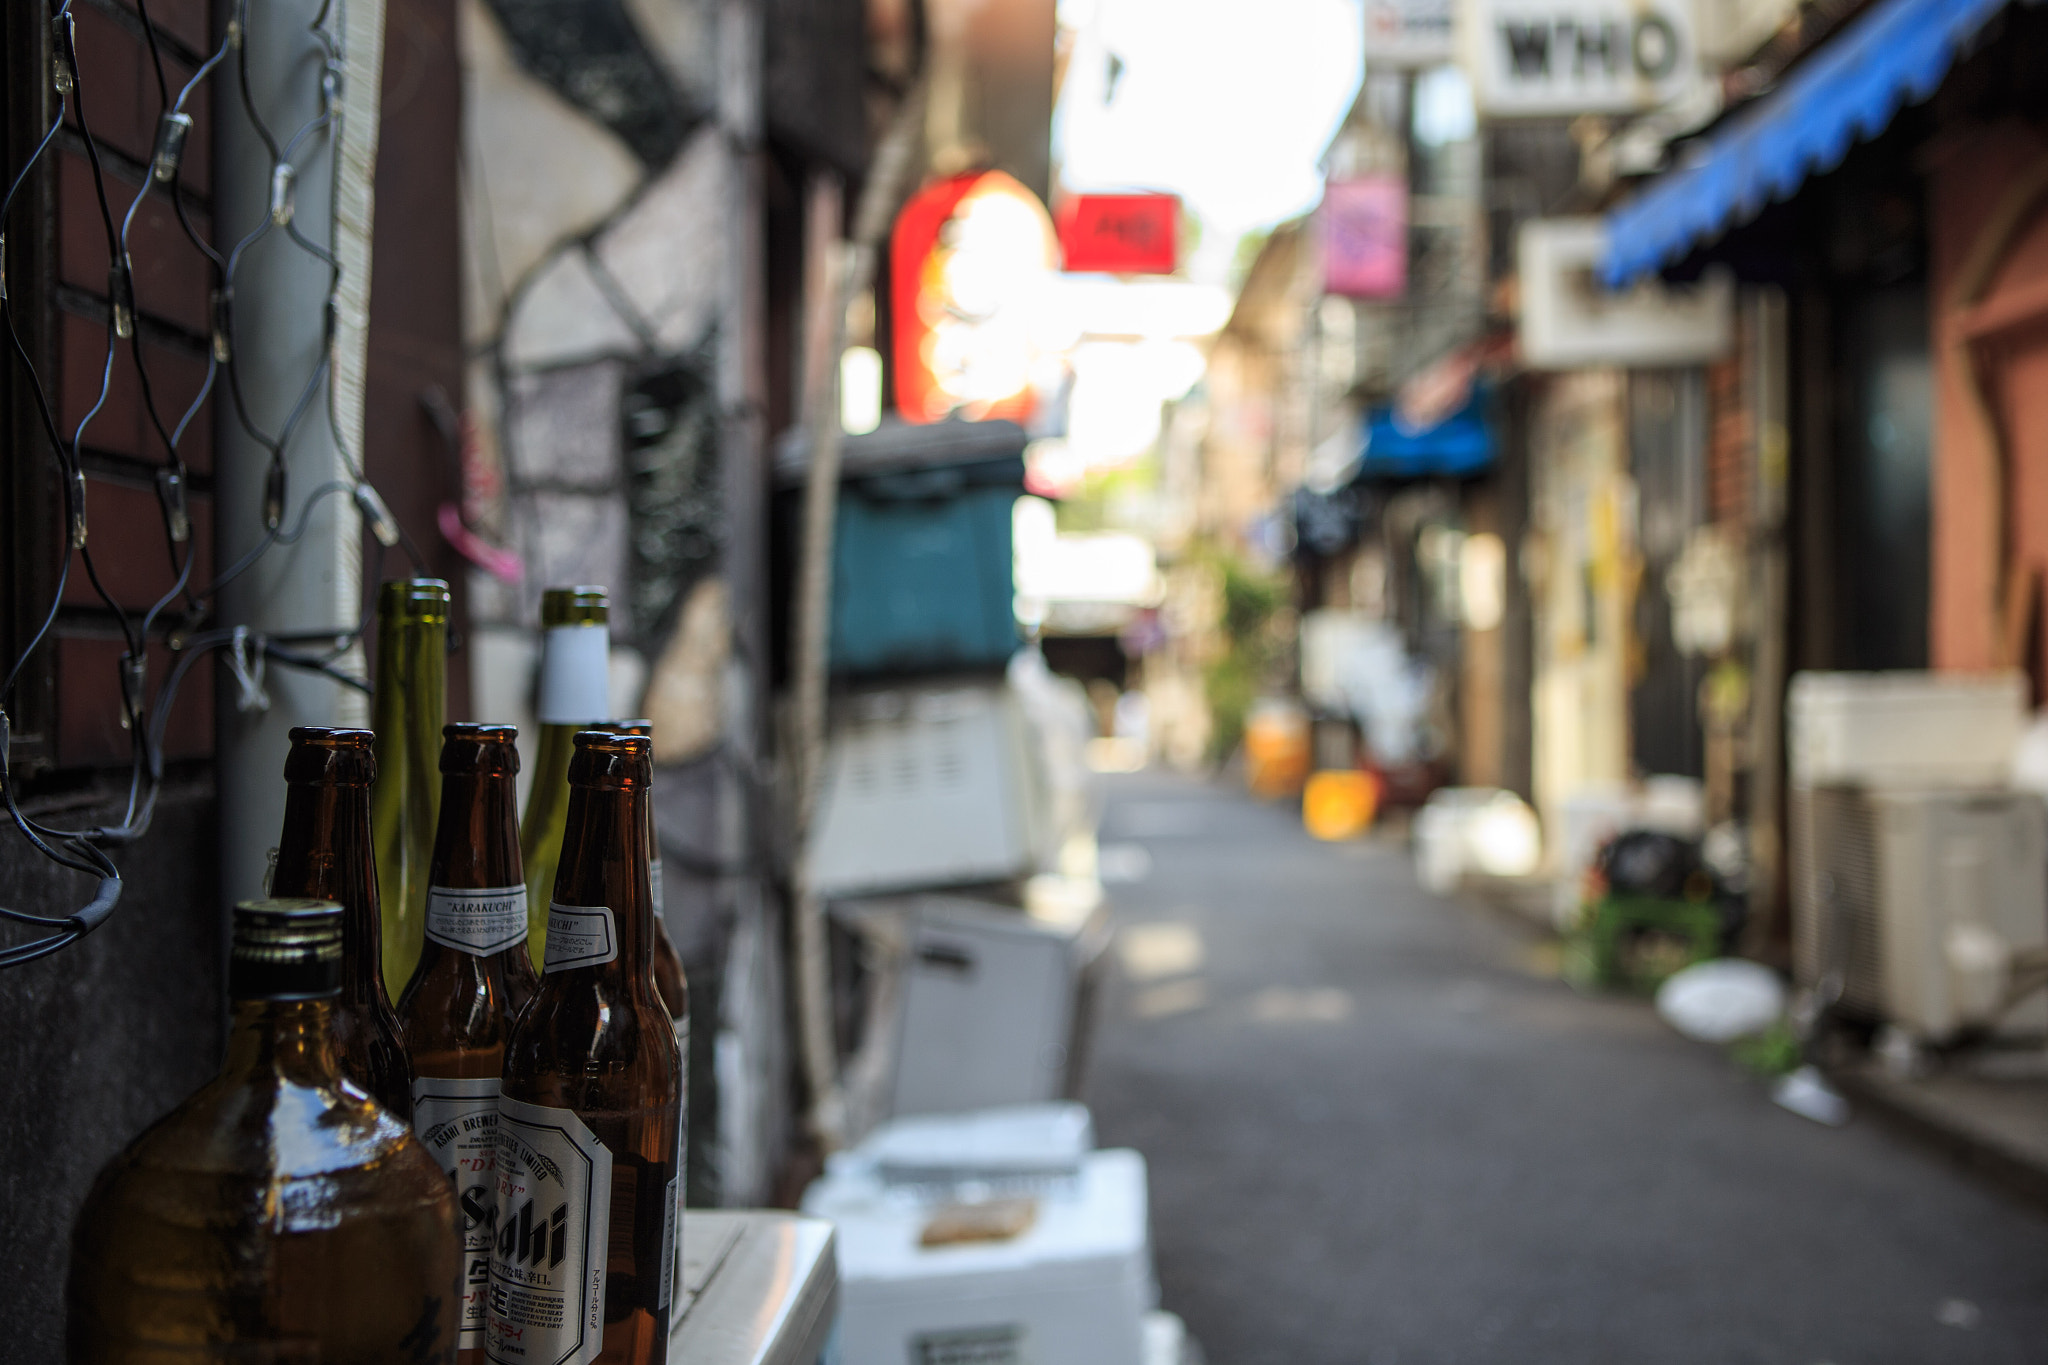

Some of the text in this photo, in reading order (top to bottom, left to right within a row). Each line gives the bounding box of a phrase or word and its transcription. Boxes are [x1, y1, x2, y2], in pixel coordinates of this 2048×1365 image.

[1499, 15, 1679, 80] WHO
[447, 900, 517, 913] "KARAKUCHI"
[433, 1124, 460, 1150] ASAHI
[519, 1148, 548, 1181] LIMITED
[590, 1269, 601, 1330] アルコール分5%
